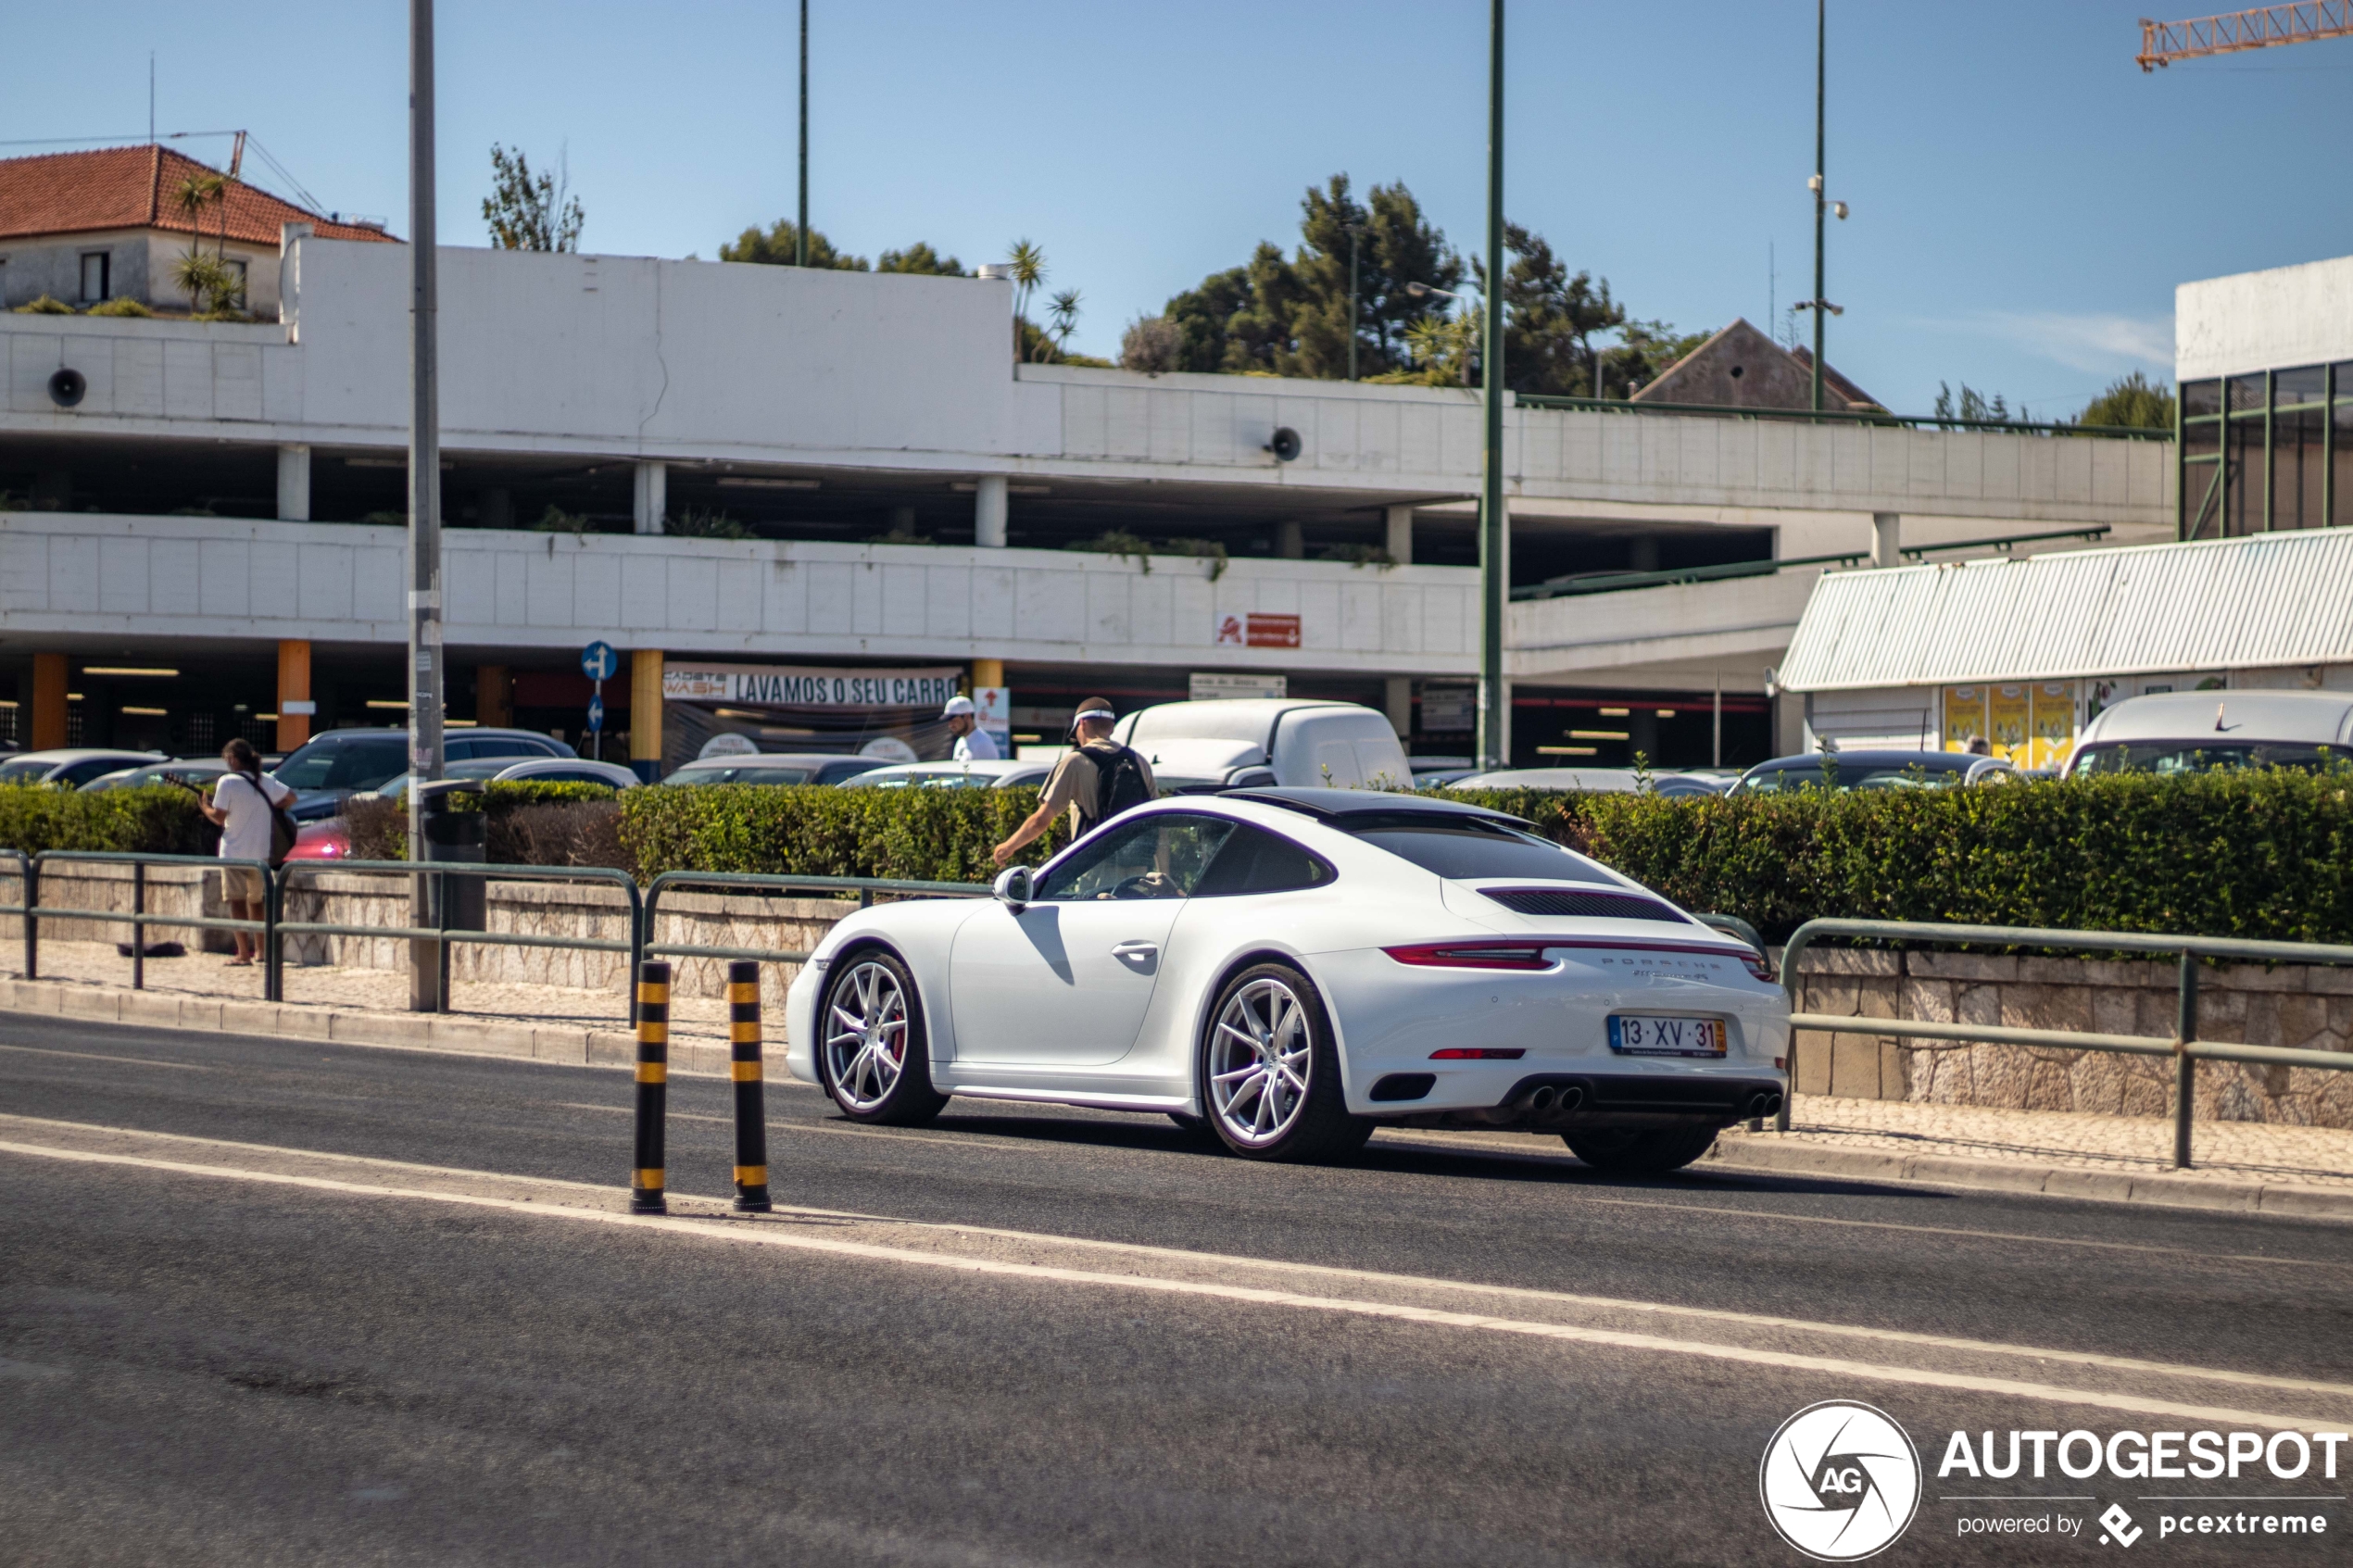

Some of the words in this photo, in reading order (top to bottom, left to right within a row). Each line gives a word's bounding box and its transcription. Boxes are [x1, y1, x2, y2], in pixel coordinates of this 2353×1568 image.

[663, 683, 725, 695] WASH
[736, 674, 827, 703] LAVAMOS
[833, 677, 845, 704] O
[851, 678, 887, 704] SEU
[1602, 958, 1721, 970] PORSCHE
